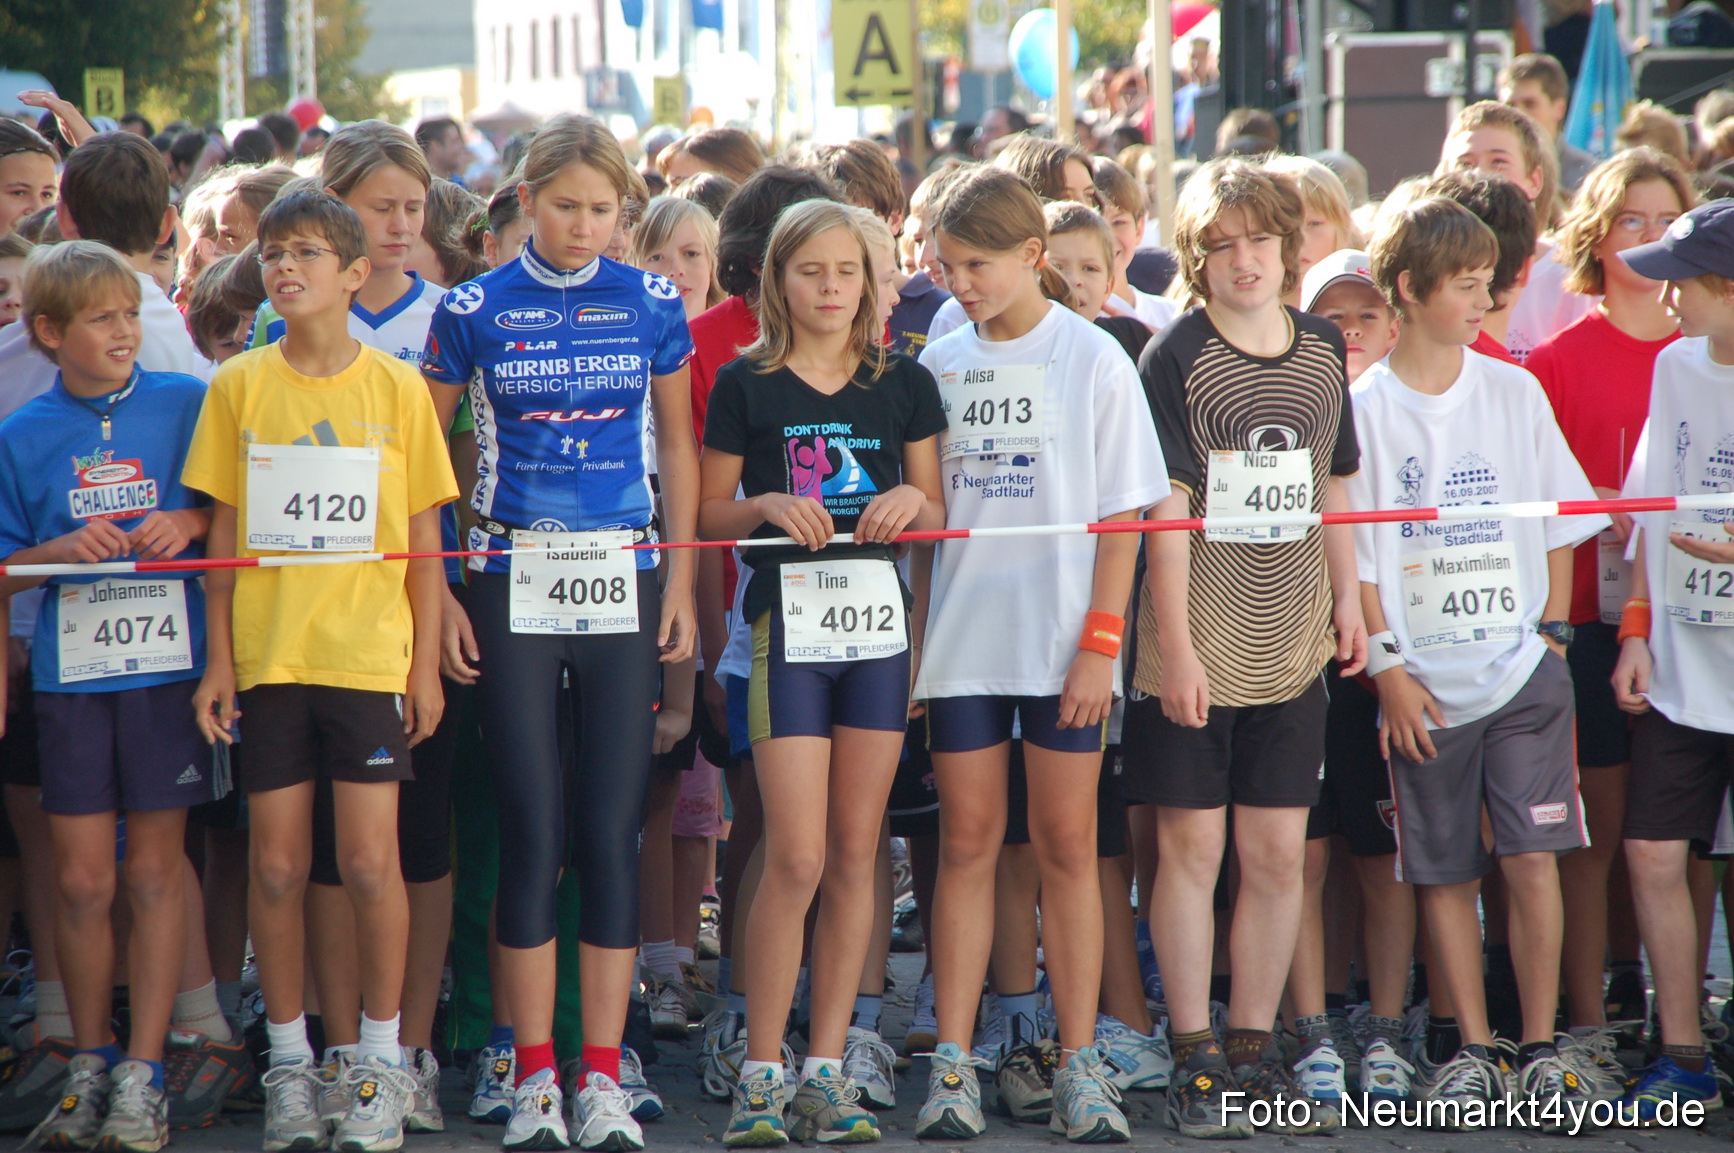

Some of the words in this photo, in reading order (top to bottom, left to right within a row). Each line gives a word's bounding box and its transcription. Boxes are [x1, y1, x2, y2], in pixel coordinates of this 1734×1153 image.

[853, 13, 900, 76] A
[578, 312, 629, 321] maxim
[505, 341, 558, 351] POLAR
[964, 369, 995, 385] Alisa
[496, 375, 642, 394] VERSICHERUNG
[520, 408, 626, 423] FUJI
[962, 397, 1032, 426] 4013
[784, 425, 820, 437] DON'T
[847, 438, 881, 450] DRIVE
[995, 437, 1040, 446] PFLEIDERER
[515, 462, 538, 472] Fürst
[540, 462, 575, 474] Fugger
[582, 459, 625, 471] Privatbank
[1244, 451, 1278, 468] Nico
[1214, 478, 1228, 492] Ju
[1444, 485, 1499, 499] 16.09.2007
[72, 482, 155, 516] CHALLENGE
[824, 498, 838, 506] WIR
[1245, 482, 1307, 512] 4056
[284, 493, 366, 522] 4120
[1401, 521, 1420, 538] 8.
[1424, 520, 1502, 536] Neumarkter
[249, 534, 295, 544] BOCK
[326, 535, 373, 544] PFLEIDERER
[1444, 530, 1504, 547] Stadtlauf
[1432, 552, 1511, 576] Maximilian
[517, 571, 531, 584] Ju
[815, 571, 848, 589] Tina
[1604, 568, 1618, 581] Ju
[88, 582, 167, 603] Johannes
[548, 577, 627, 605] 4008
[1410, 592, 1424, 606] Ju
[1442, 587, 1516, 617] 4076
[788, 602, 802, 615] Ju
[512, 618, 560, 628] BOCK
[590, 617, 636, 626] PFLEIDERER
[820, 605, 894, 632] 4012
[63, 620, 77, 634] Ju
[94, 615, 178, 646] 4074
[787, 646, 831, 656] BOCK
[859, 642, 905, 653] PFLEIDERER
[139, 655, 189, 666] PFLEIDERER
[367, 757, 394, 765] adidas
[176, 776, 202, 784] adidas
